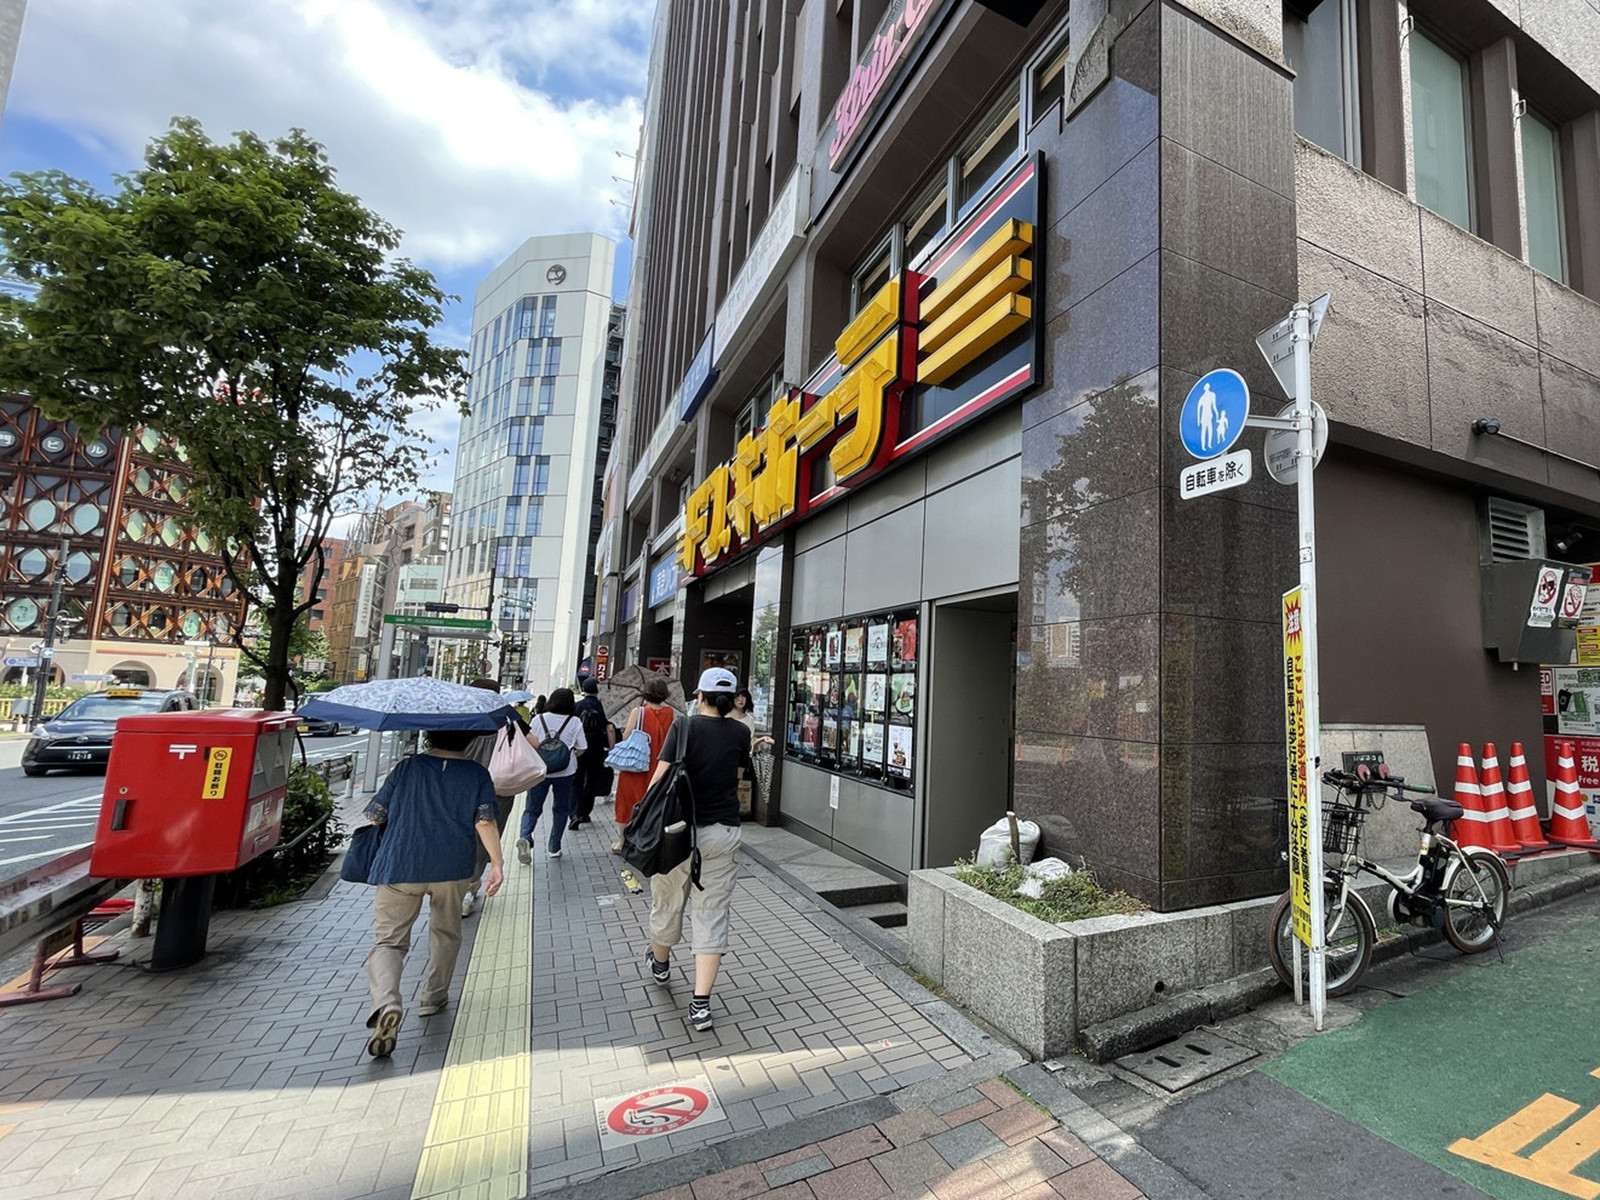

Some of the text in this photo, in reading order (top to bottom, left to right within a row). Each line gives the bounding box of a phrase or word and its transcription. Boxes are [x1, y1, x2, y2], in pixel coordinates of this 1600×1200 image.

[1186, 460, 1245, 492] 自転車を除く
[1581, 755, 1600, 773] 税
[1578, 775, 1599, 785] Free
